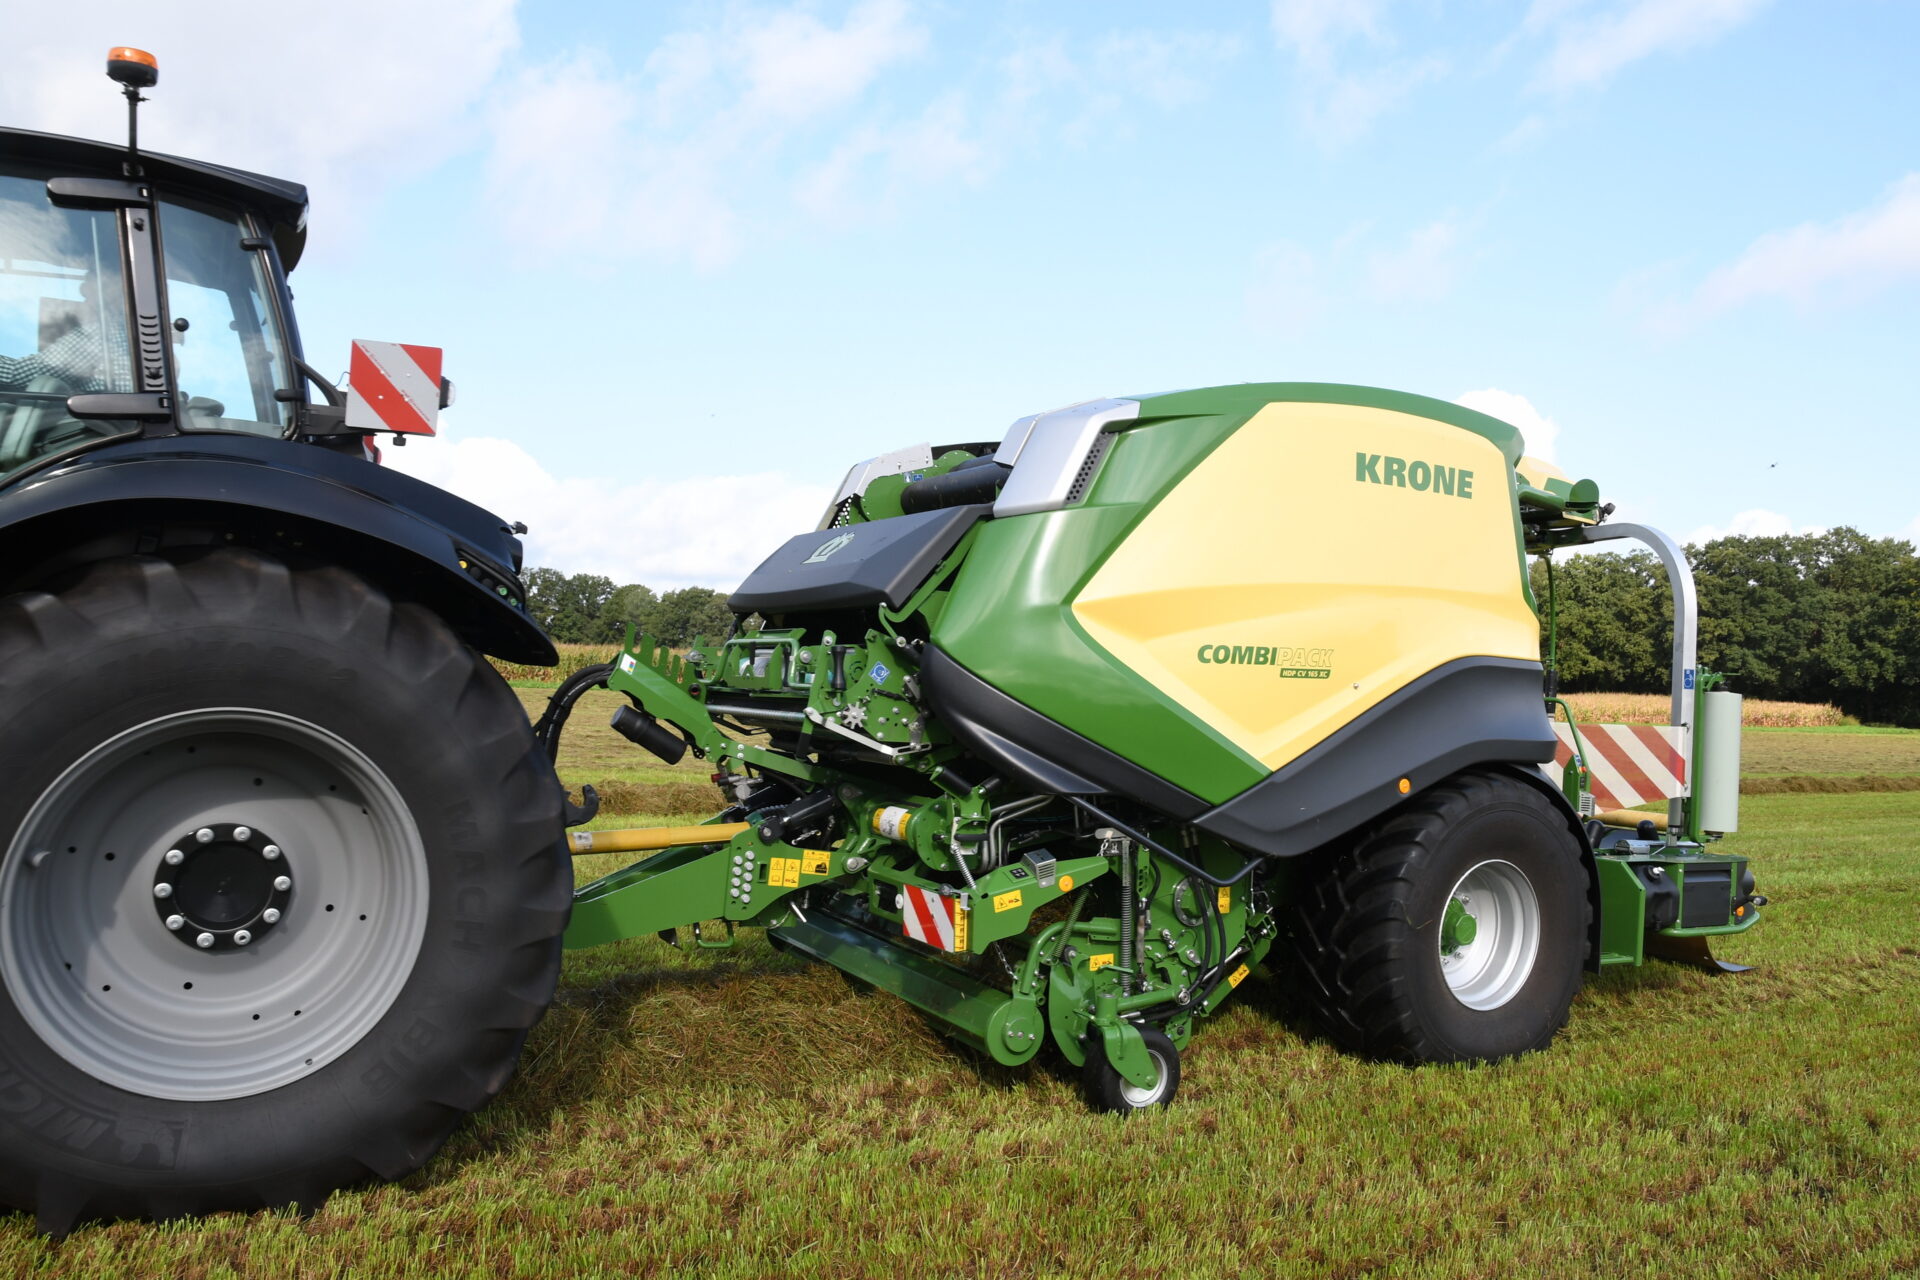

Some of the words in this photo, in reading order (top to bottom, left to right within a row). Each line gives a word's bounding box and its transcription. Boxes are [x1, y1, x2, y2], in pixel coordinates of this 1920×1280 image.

[1355, 451, 1474, 500] KRONE
[1282, 669, 1296, 677] HDP
[1308, 670, 1319, 678] 165
